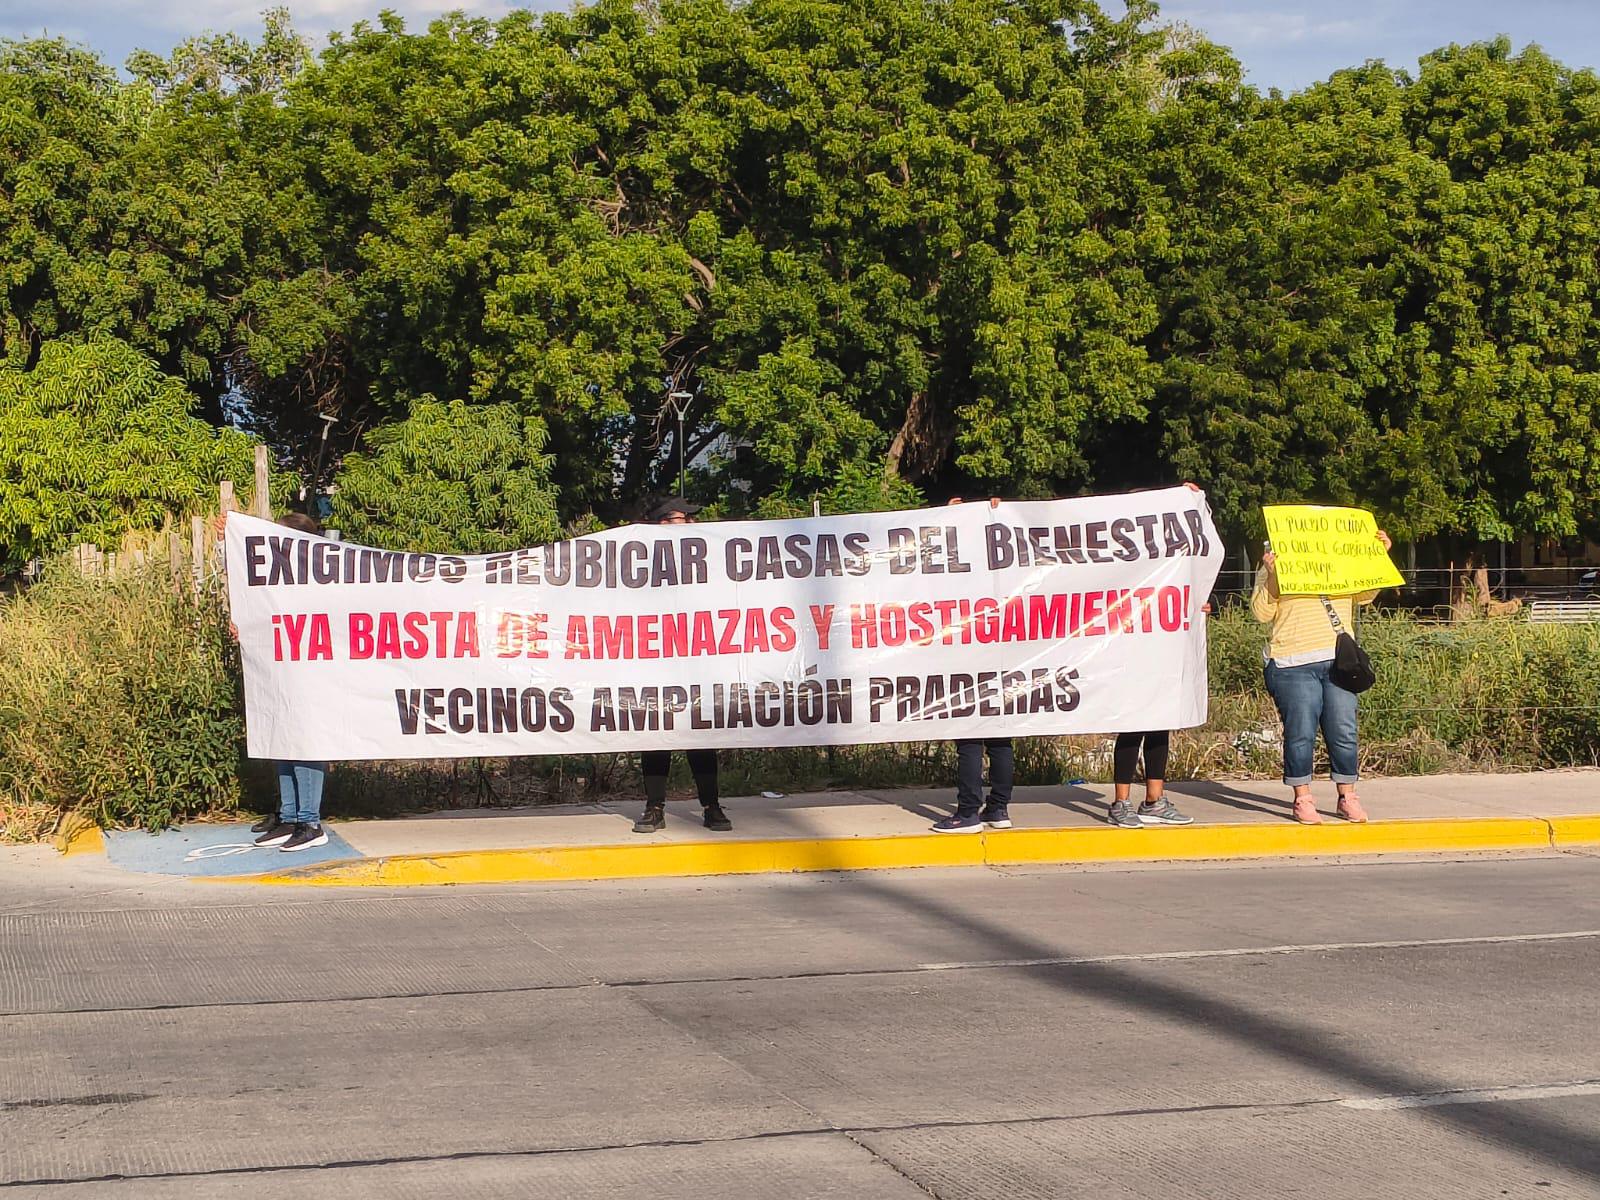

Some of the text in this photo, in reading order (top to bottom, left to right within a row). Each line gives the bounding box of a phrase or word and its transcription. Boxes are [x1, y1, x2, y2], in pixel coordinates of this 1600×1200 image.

[245, 509, 1209, 588] EXIGIMOS REUBICAR CASAS DEL BIENESTAR
[272, 585, 1191, 661] ¡YA BASTA DE AMENAZAS Y HOSTIGAMIENTO!
[395, 664, 1080, 735] VECINOS AMPLIACIÓN PRADERAS
